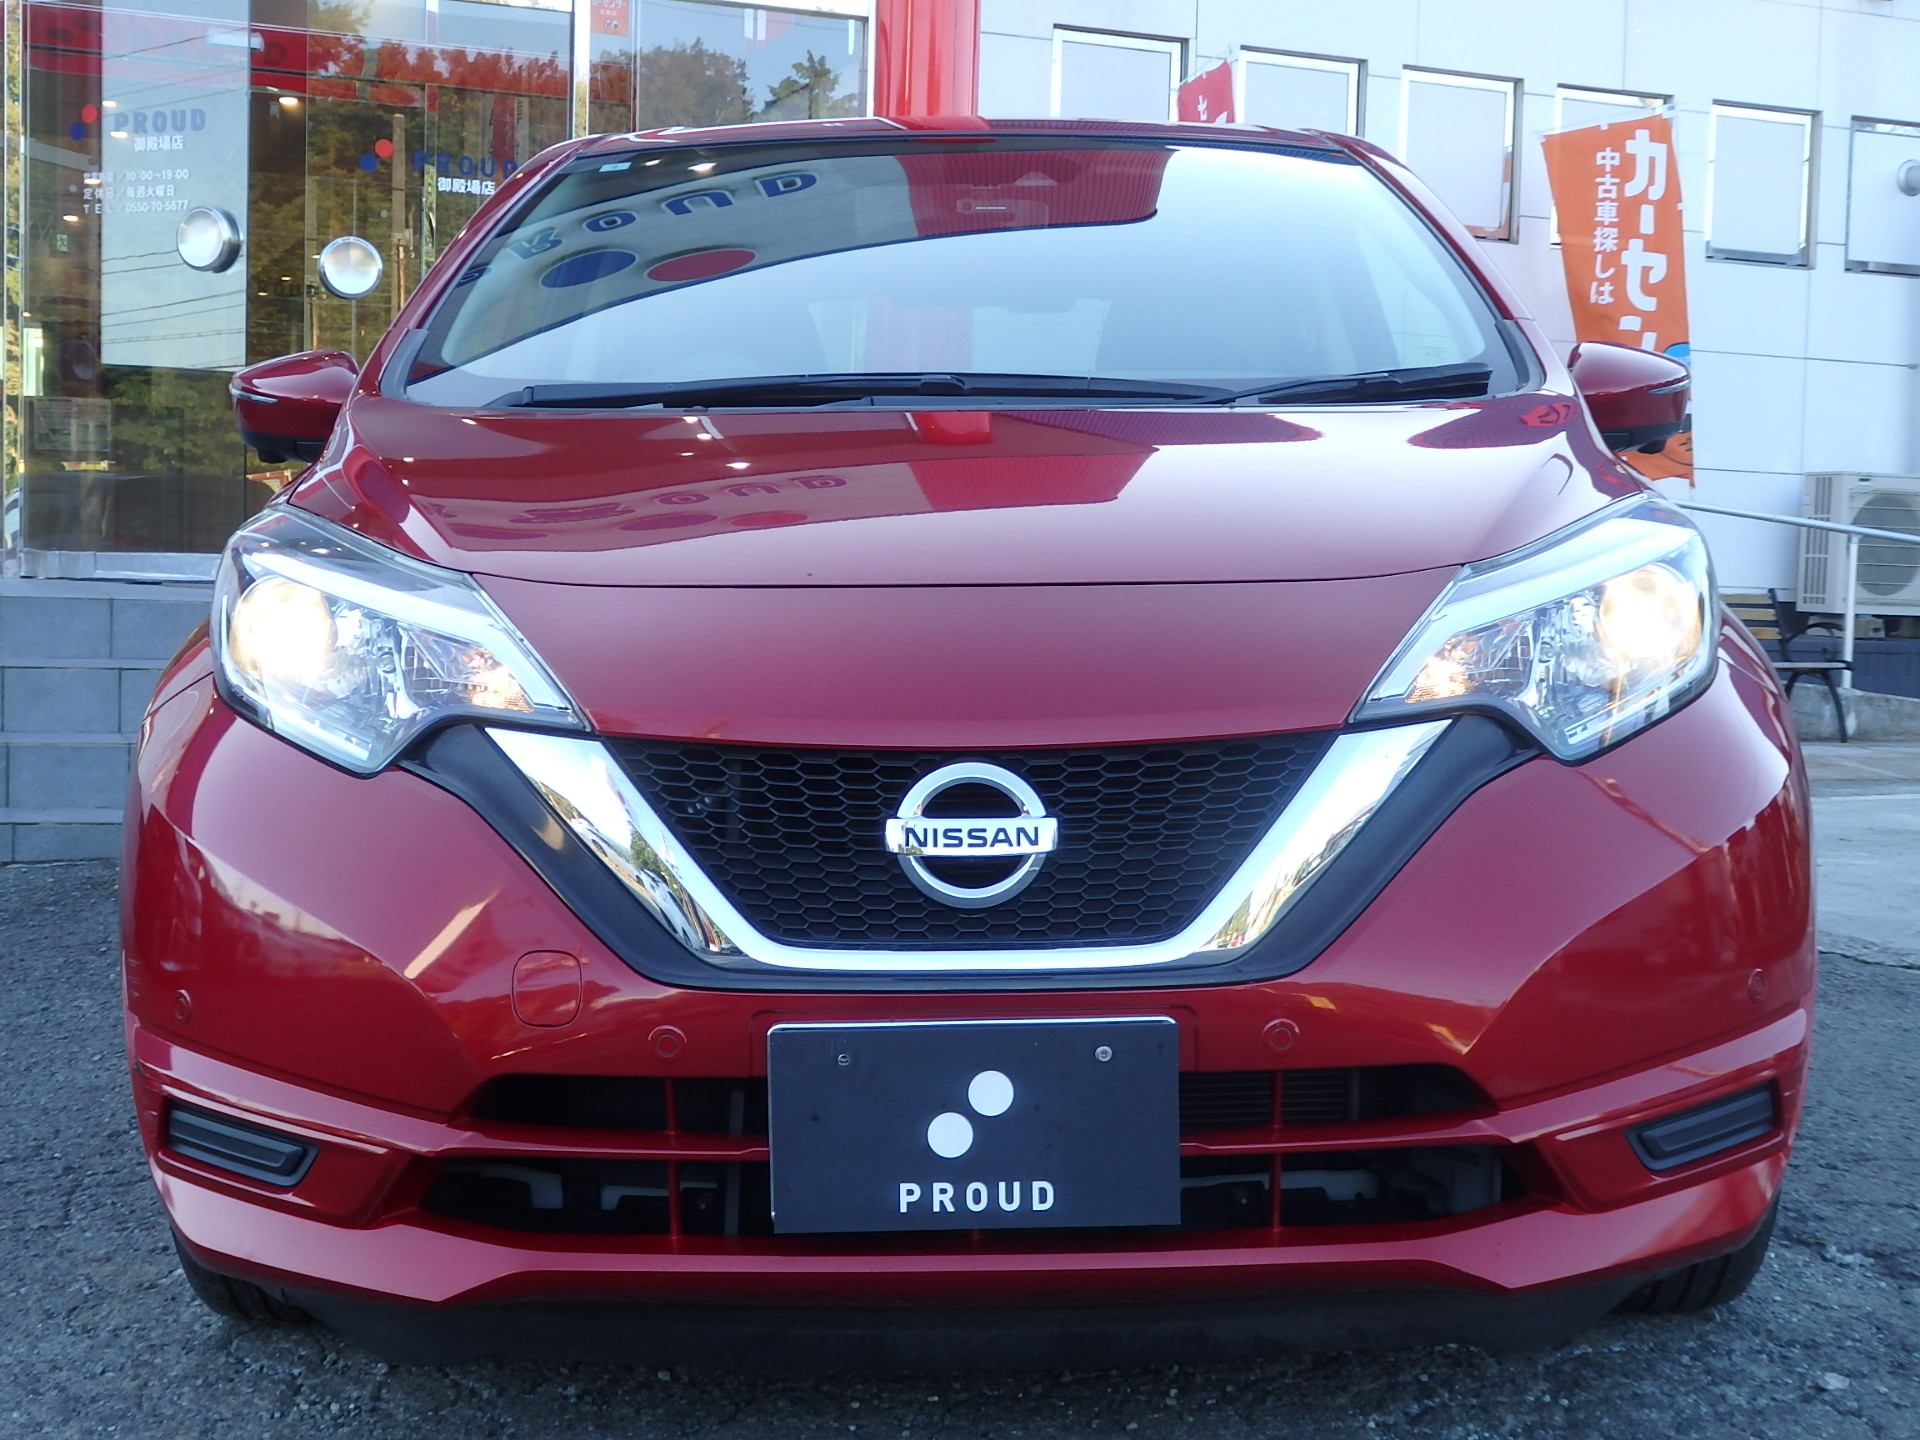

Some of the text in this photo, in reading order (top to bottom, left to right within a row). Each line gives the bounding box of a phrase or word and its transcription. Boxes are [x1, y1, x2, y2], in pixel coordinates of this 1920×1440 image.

[114, 108, 206, 135] PROUD
[134, 135, 184, 151] 御殿場店
[413, 151, 519, 180] PROUD
[437, 176, 496, 195] 御殿場店
[1589, 147, 1621, 304] 中古車探しは
[904, 826, 1040, 848] NISSAN
[899, 1180, 1054, 1213] PROUD
